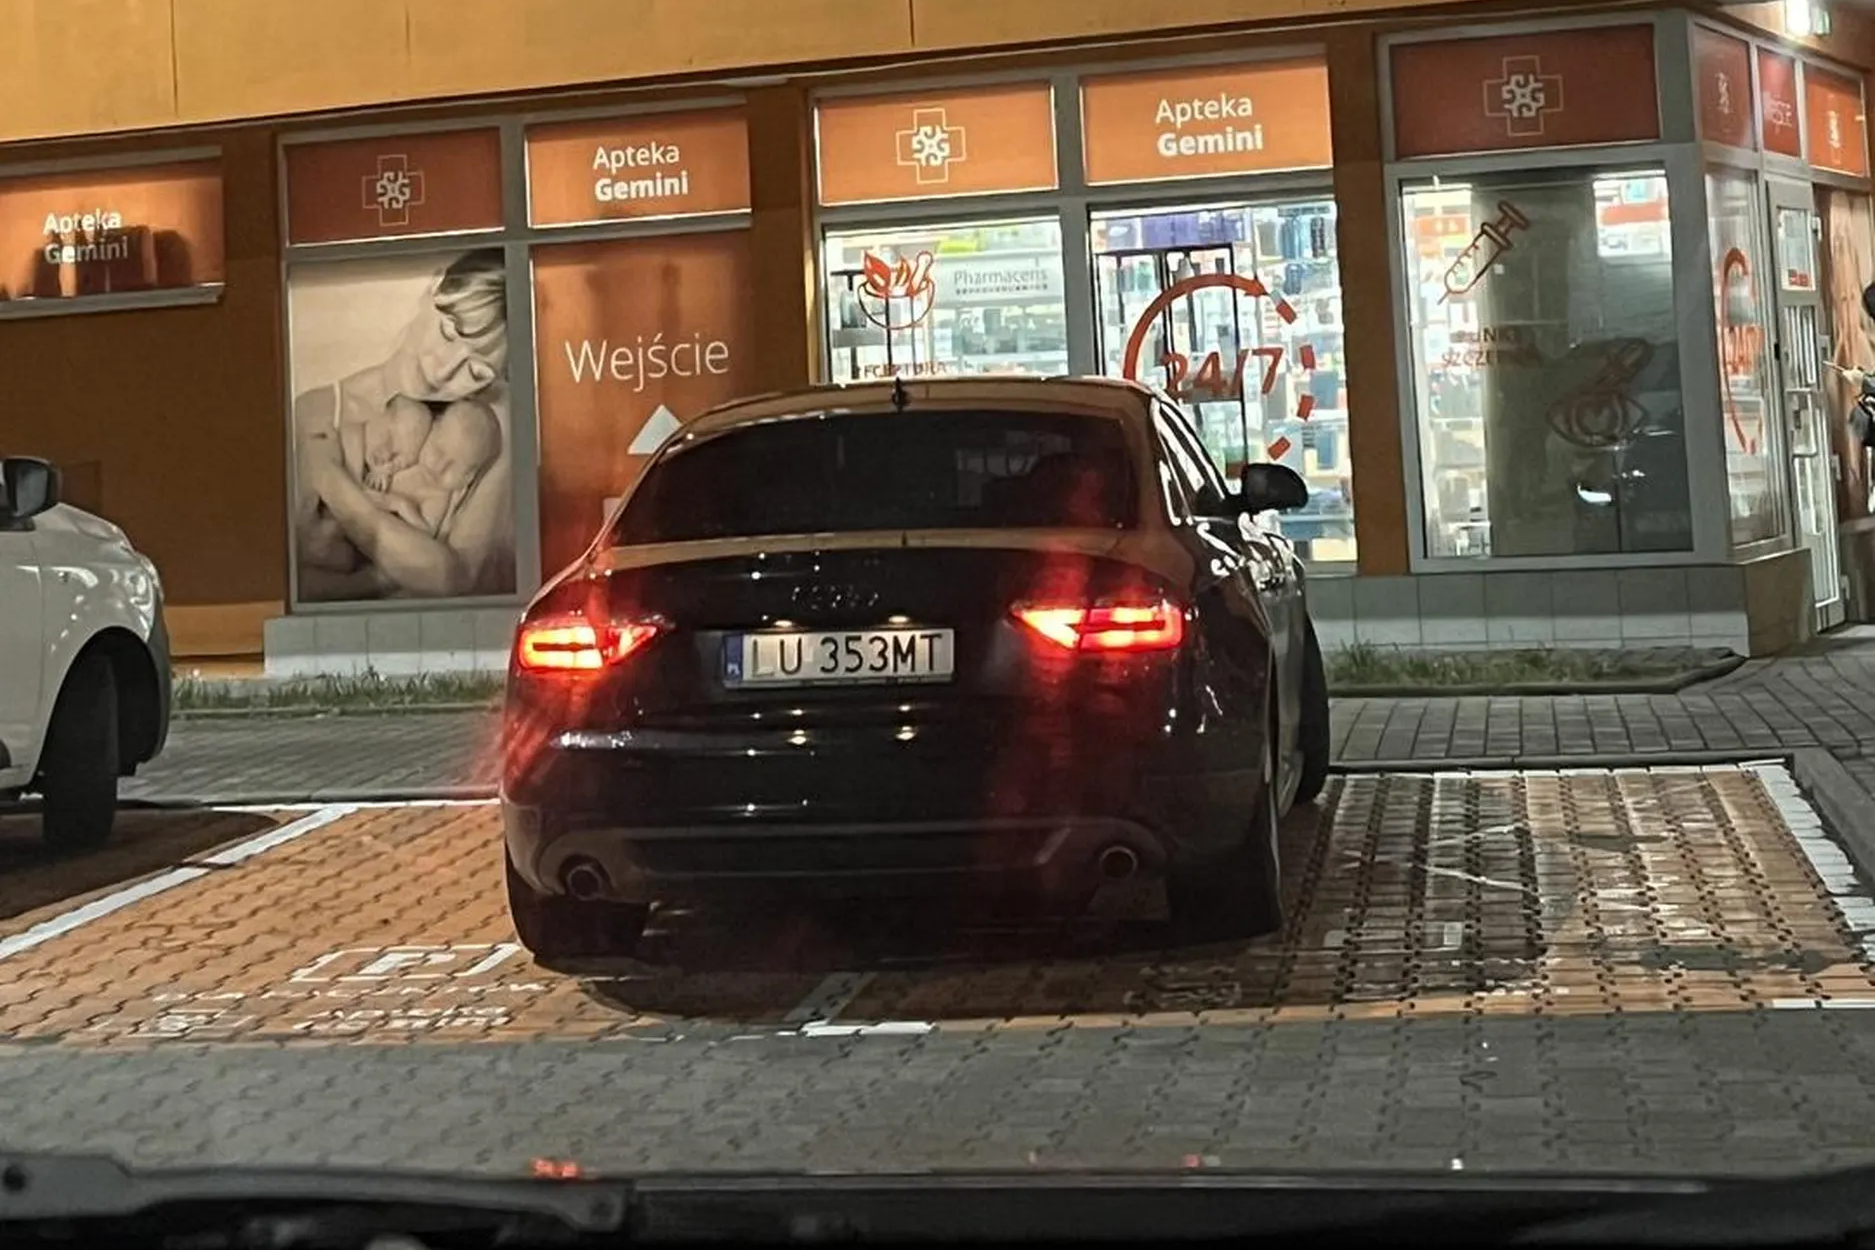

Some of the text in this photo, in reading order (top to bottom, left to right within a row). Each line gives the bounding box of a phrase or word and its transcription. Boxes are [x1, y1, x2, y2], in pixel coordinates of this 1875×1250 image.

[1155, 92, 1253, 129] Apteka
[1157, 124, 1263, 157] Gemini
[592, 141, 680, 174] Apteka
[595, 170, 688, 201] Gemini
[43, 208, 122, 236] Apteka
[44, 235, 128, 264] Gemini
[565, 331, 729, 392] Wejście
[1161, 347, 1285, 399] 24/7
[752, 633, 943, 677] LU 353MT
